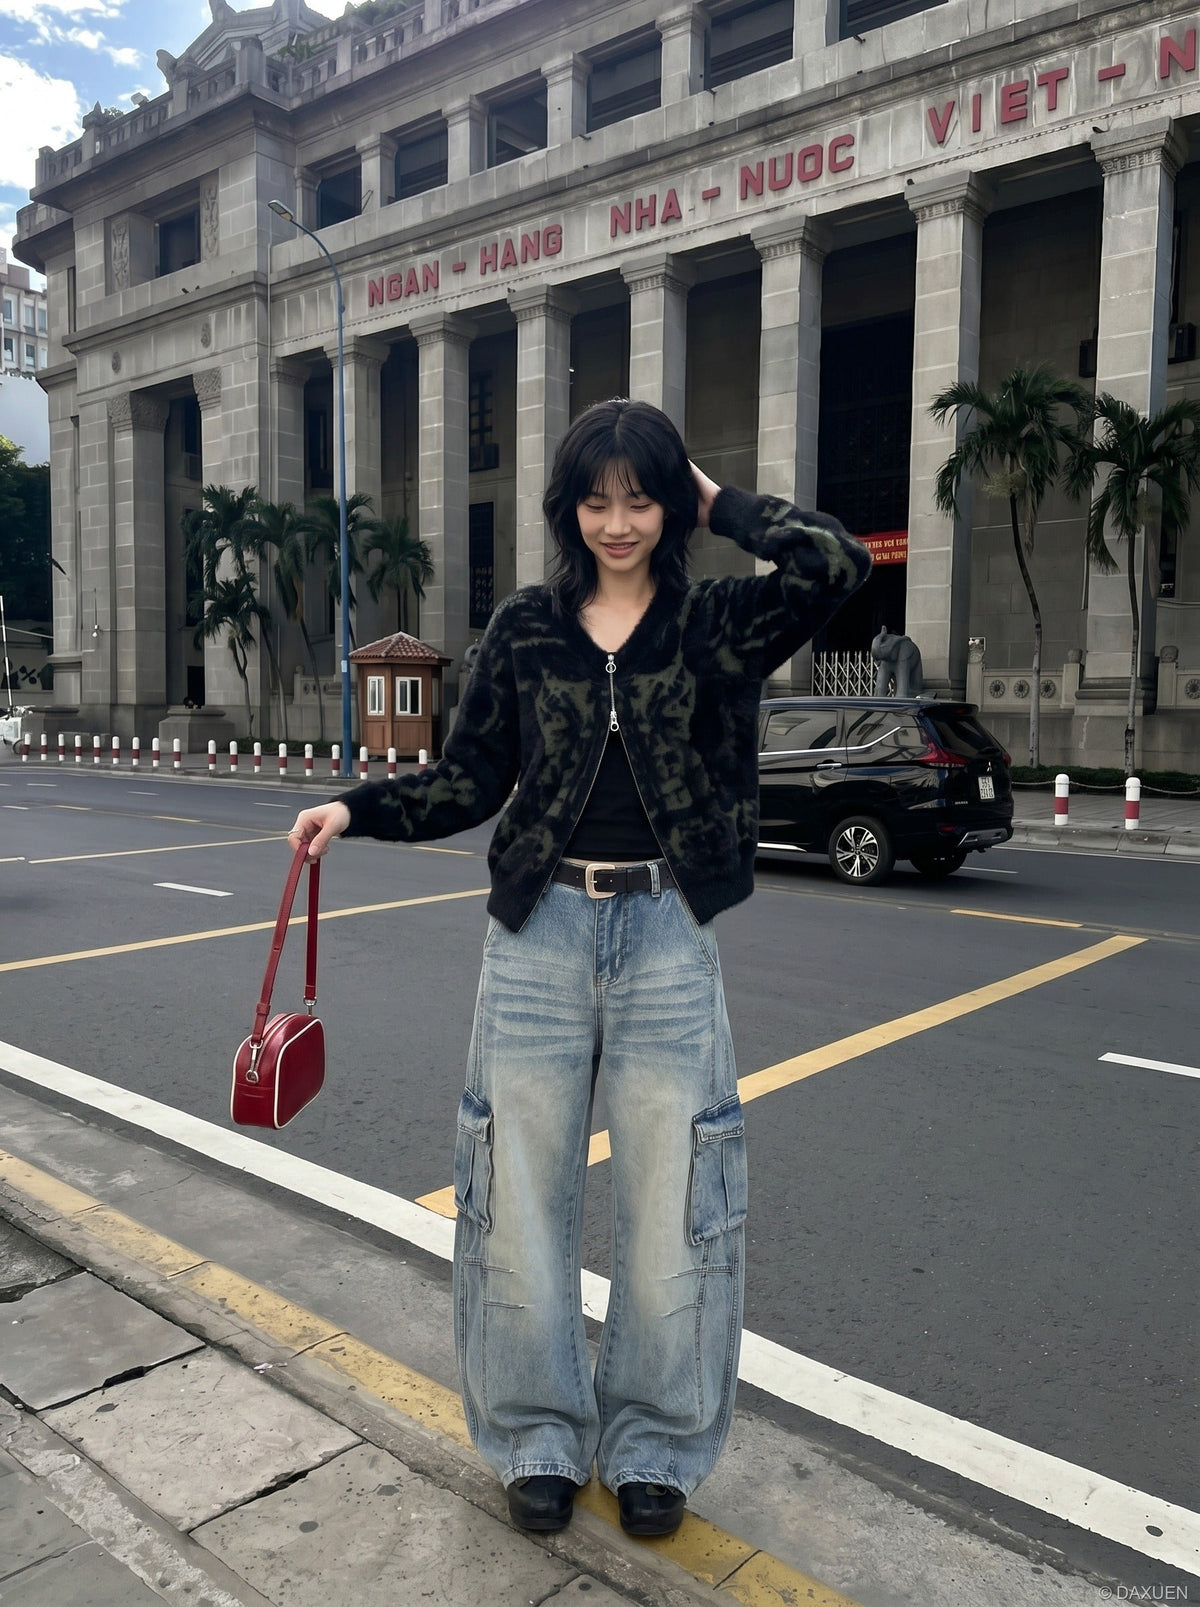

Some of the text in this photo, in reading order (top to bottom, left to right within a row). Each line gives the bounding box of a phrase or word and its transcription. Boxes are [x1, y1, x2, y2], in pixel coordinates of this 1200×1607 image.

[368, 260, 439, 307] NGAN
[480, 225, 562, 275] HANG
[610, 188, 683, 238] NHA
[740, 134, 856, 200] NUOC
[927, 67, 1070, 144] VIET
